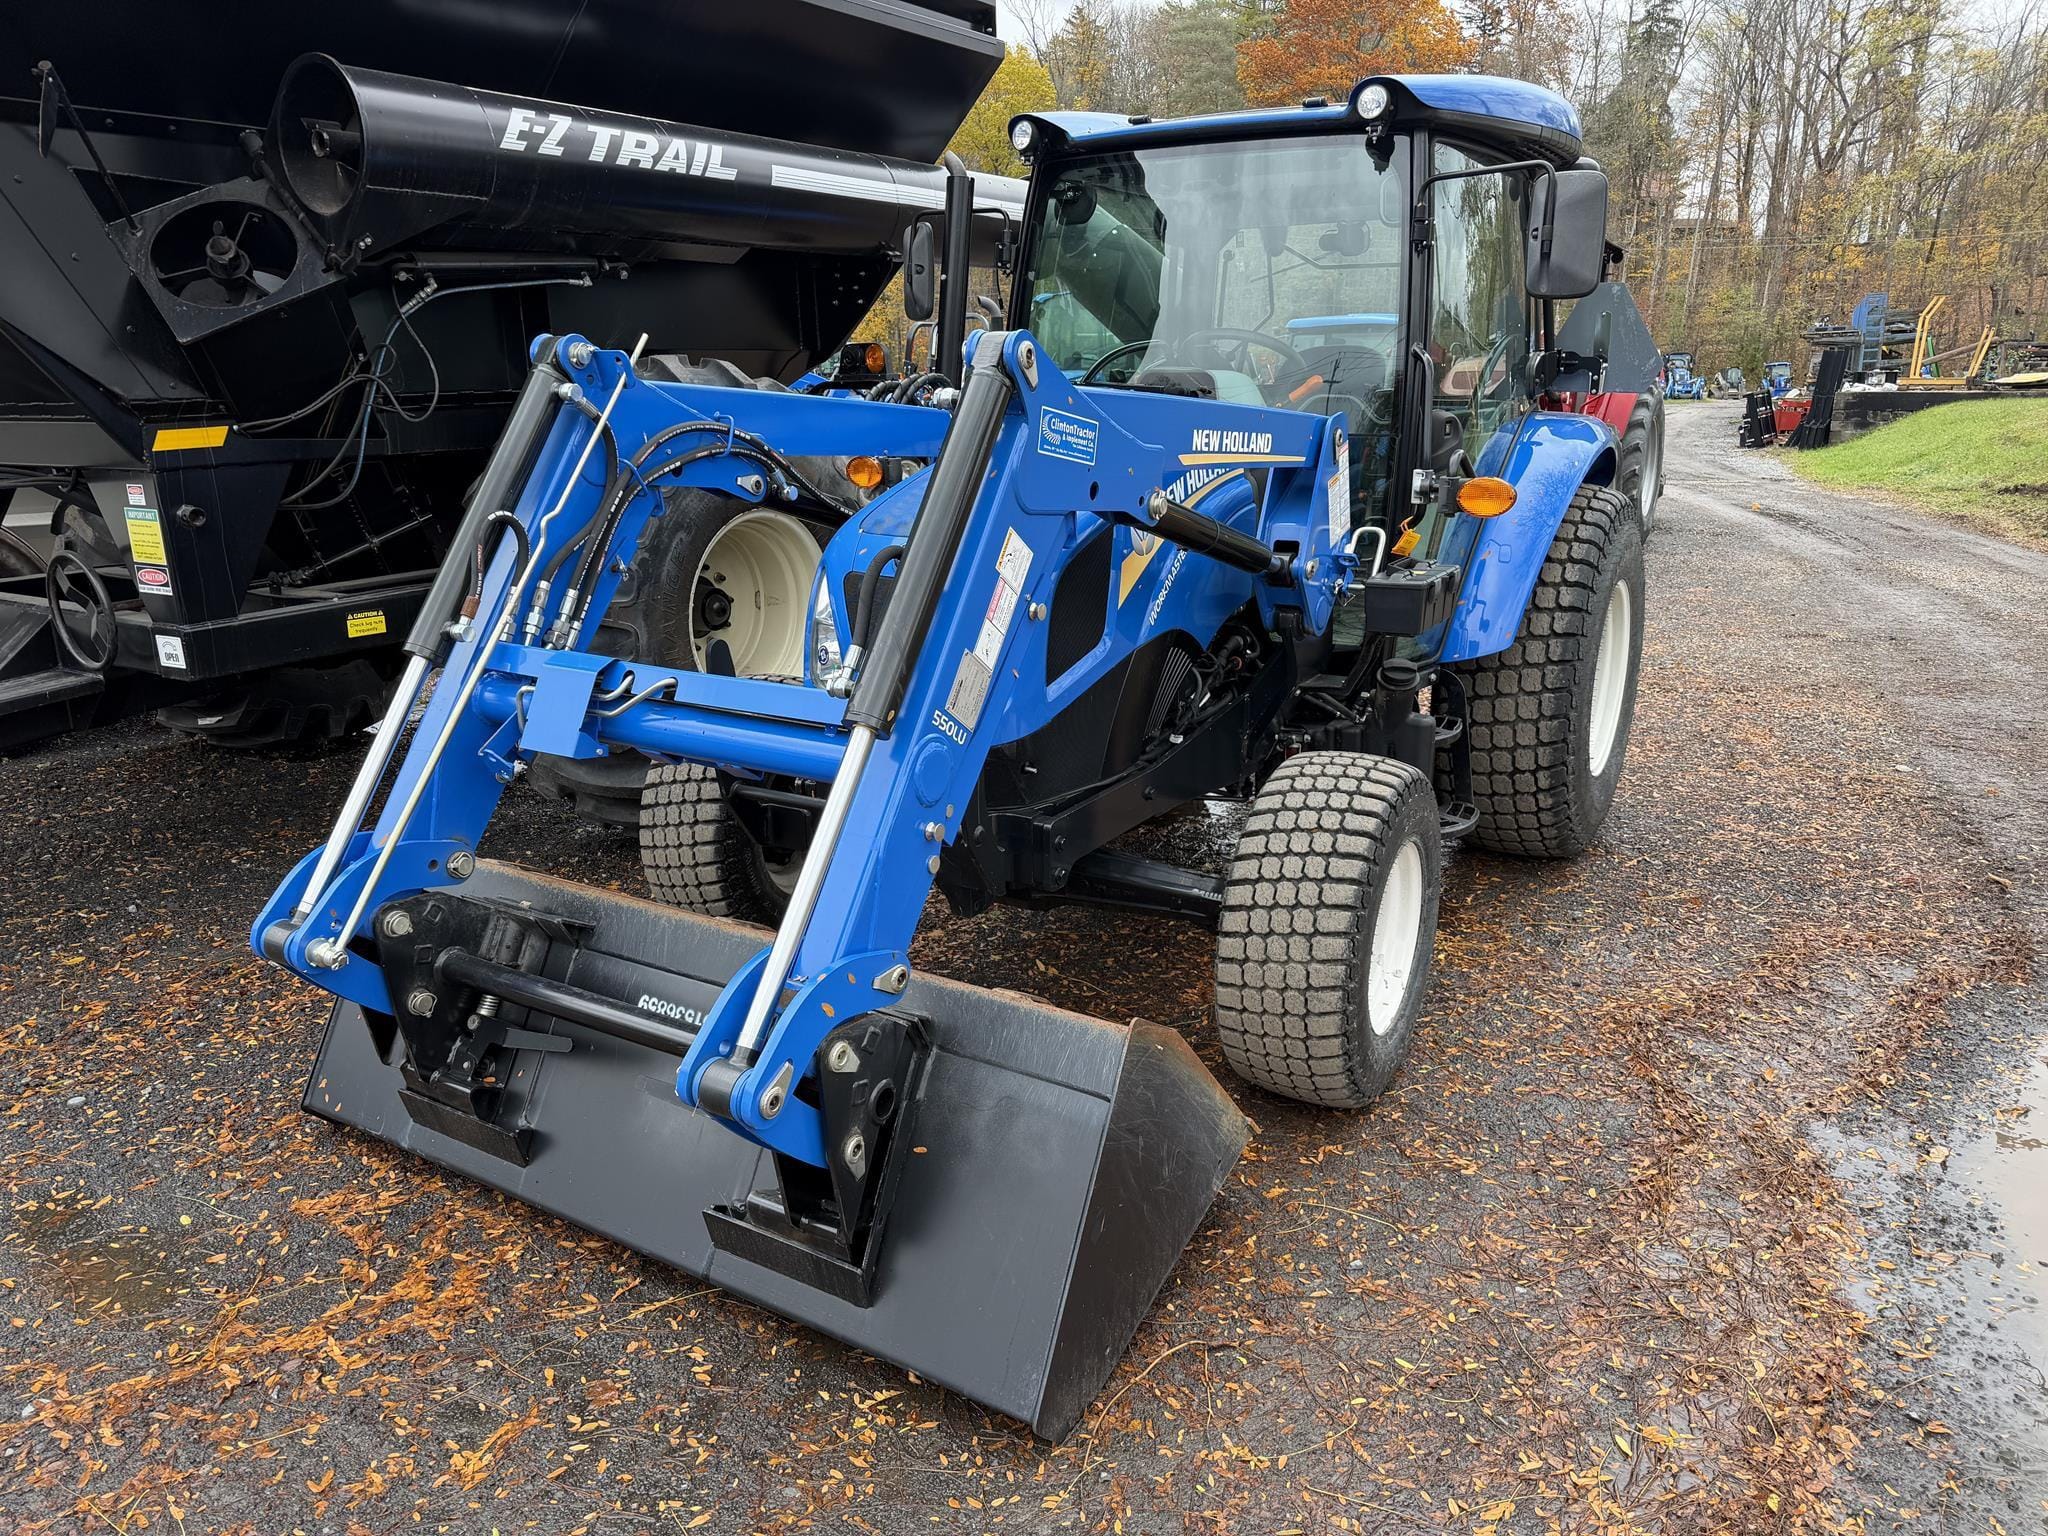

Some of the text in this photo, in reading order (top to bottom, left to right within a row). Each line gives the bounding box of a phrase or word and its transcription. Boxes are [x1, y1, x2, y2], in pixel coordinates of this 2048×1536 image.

[499, 107, 738, 181] E-Z TRAIL
[1192, 429, 1273, 453] NEW HOLLAND
[1166, 476, 1185, 504] EW
[127, 511, 156, 521] IMPORTANT
[141, 571, 165, 582] CAUTION
[1149, 549, 1187, 626] WORKMASTE
[353, 610, 378, 619] CAUTION
[931, 709, 967, 745] 550LU
